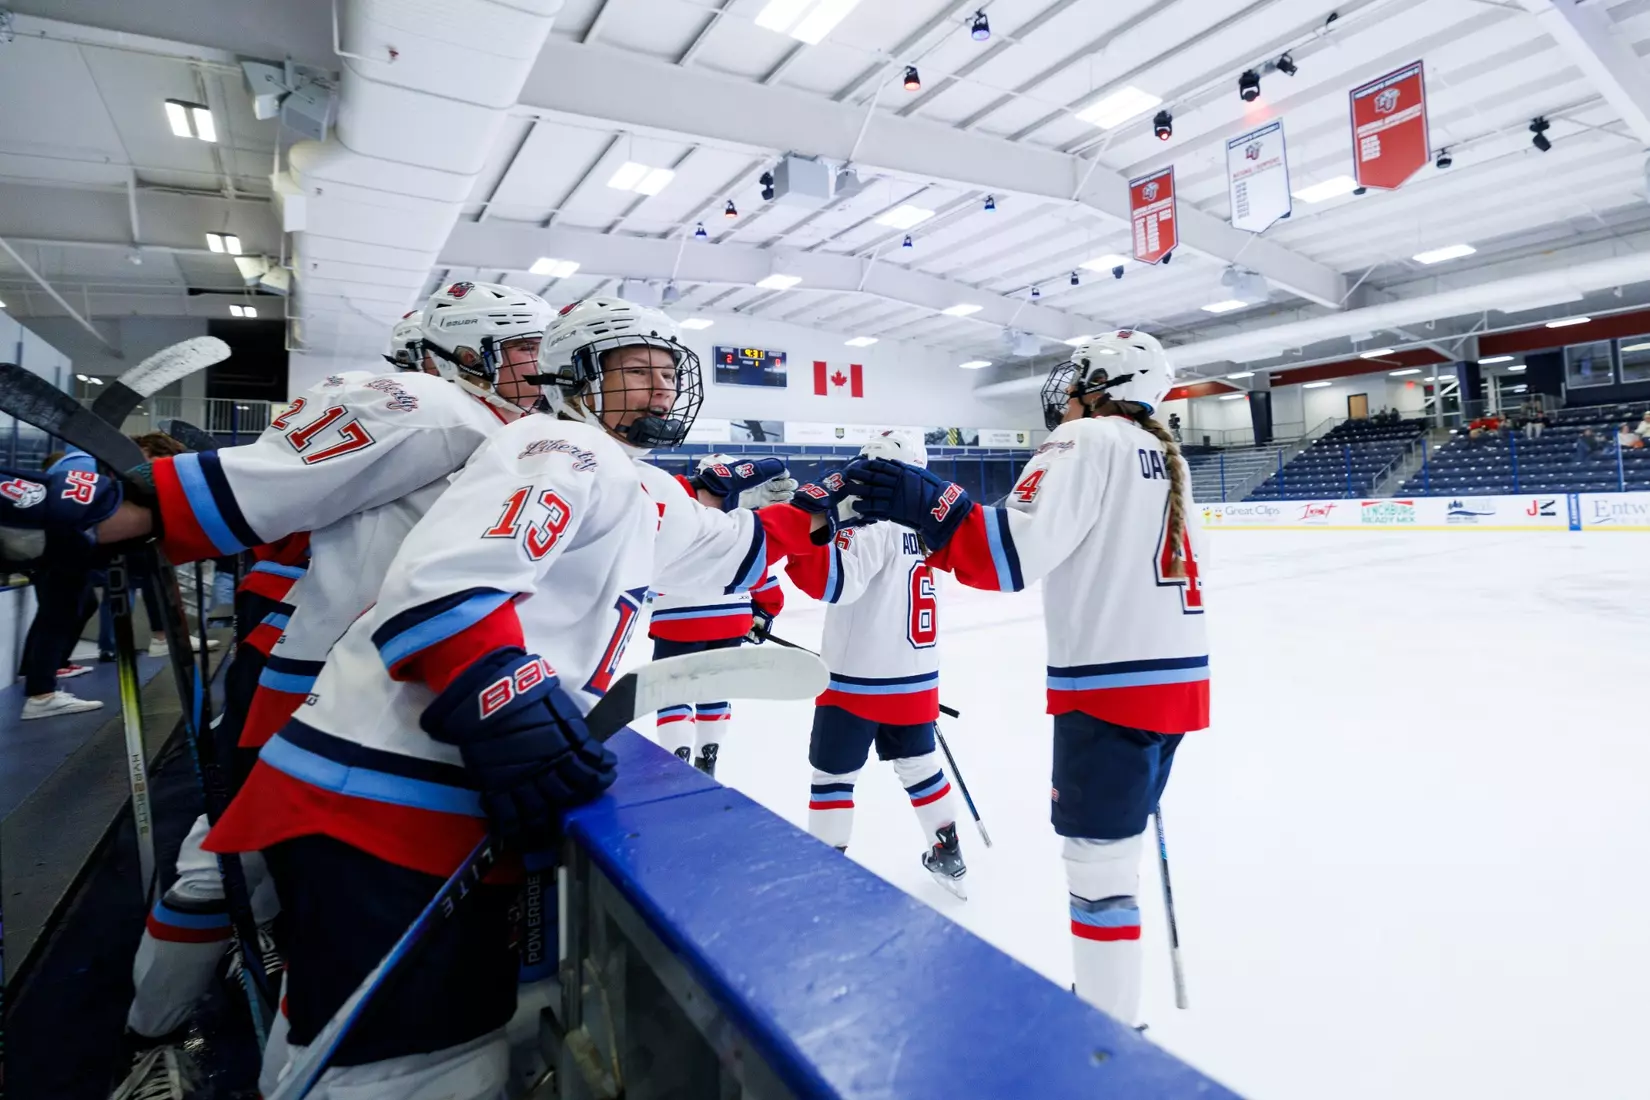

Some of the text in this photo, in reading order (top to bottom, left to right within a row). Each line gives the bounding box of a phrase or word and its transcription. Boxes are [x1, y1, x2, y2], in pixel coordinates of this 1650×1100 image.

[726, 353, 733, 364] 2
[285, 404, 376, 465] 17
[517, 438, 599, 472] Liberty
[1013, 468, 1048, 503] 4
[1225, 504, 1280, 518] Great Clips
[480, 485, 573, 562] 13
[1153, 488, 1204, 615] 4
[906, 560, 937, 650] 6
[525, 872, 543, 963] POWERADE
